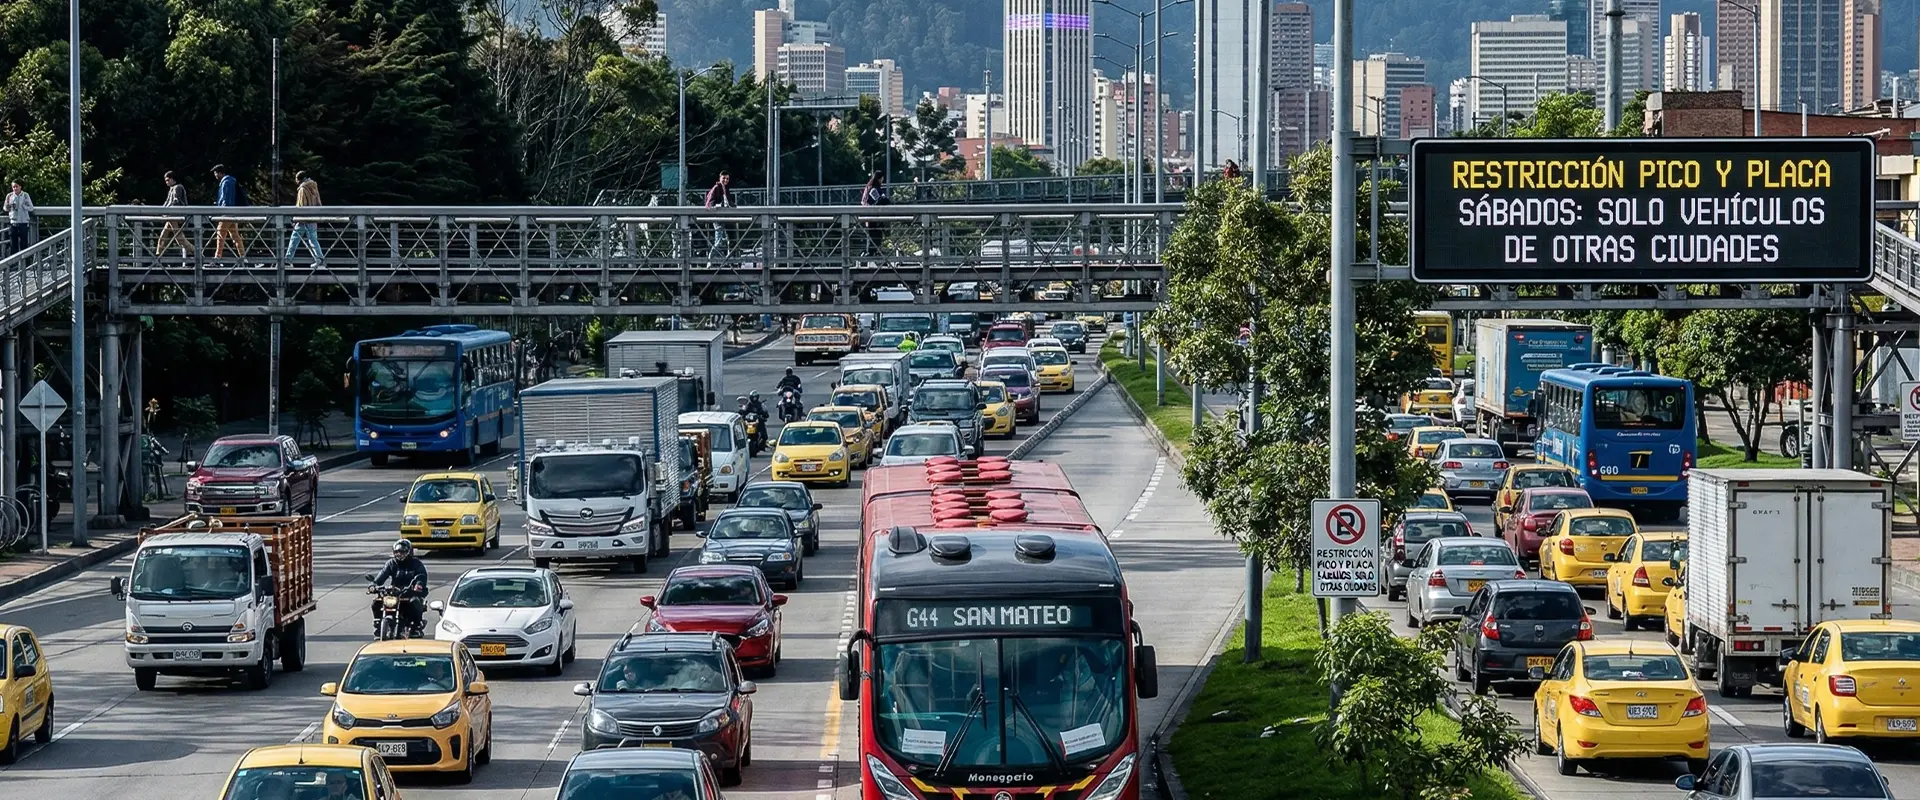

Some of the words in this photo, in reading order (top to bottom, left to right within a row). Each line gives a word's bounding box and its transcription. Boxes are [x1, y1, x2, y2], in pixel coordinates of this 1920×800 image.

[1453, 156, 1624, 189] RESTRICCIÓN
[1640, 160, 1701, 188] PICO
[1717, 160, 1732, 188] Y
[1747, 160, 1831, 188] PLACA
[1459, 193, 1583, 226] SÁBADOS:
[1598, 197, 1664, 226] SOLO
[1681, 192, 1825, 226] VEHÍCULOS
[1504, 234, 1537, 263] DE
[1553, 234, 1635, 263] OTRAS
[1652, 234, 1779, 263] CIUDADES
[1316, 547, 1374, 558] RESTRICCIÓN
[1338, 560, 1344, 569] Y
[906, 607, 939, 628] G44
[953, 606, 996, 627] SAN
[1000, 605, 1071, 626] MATEO
